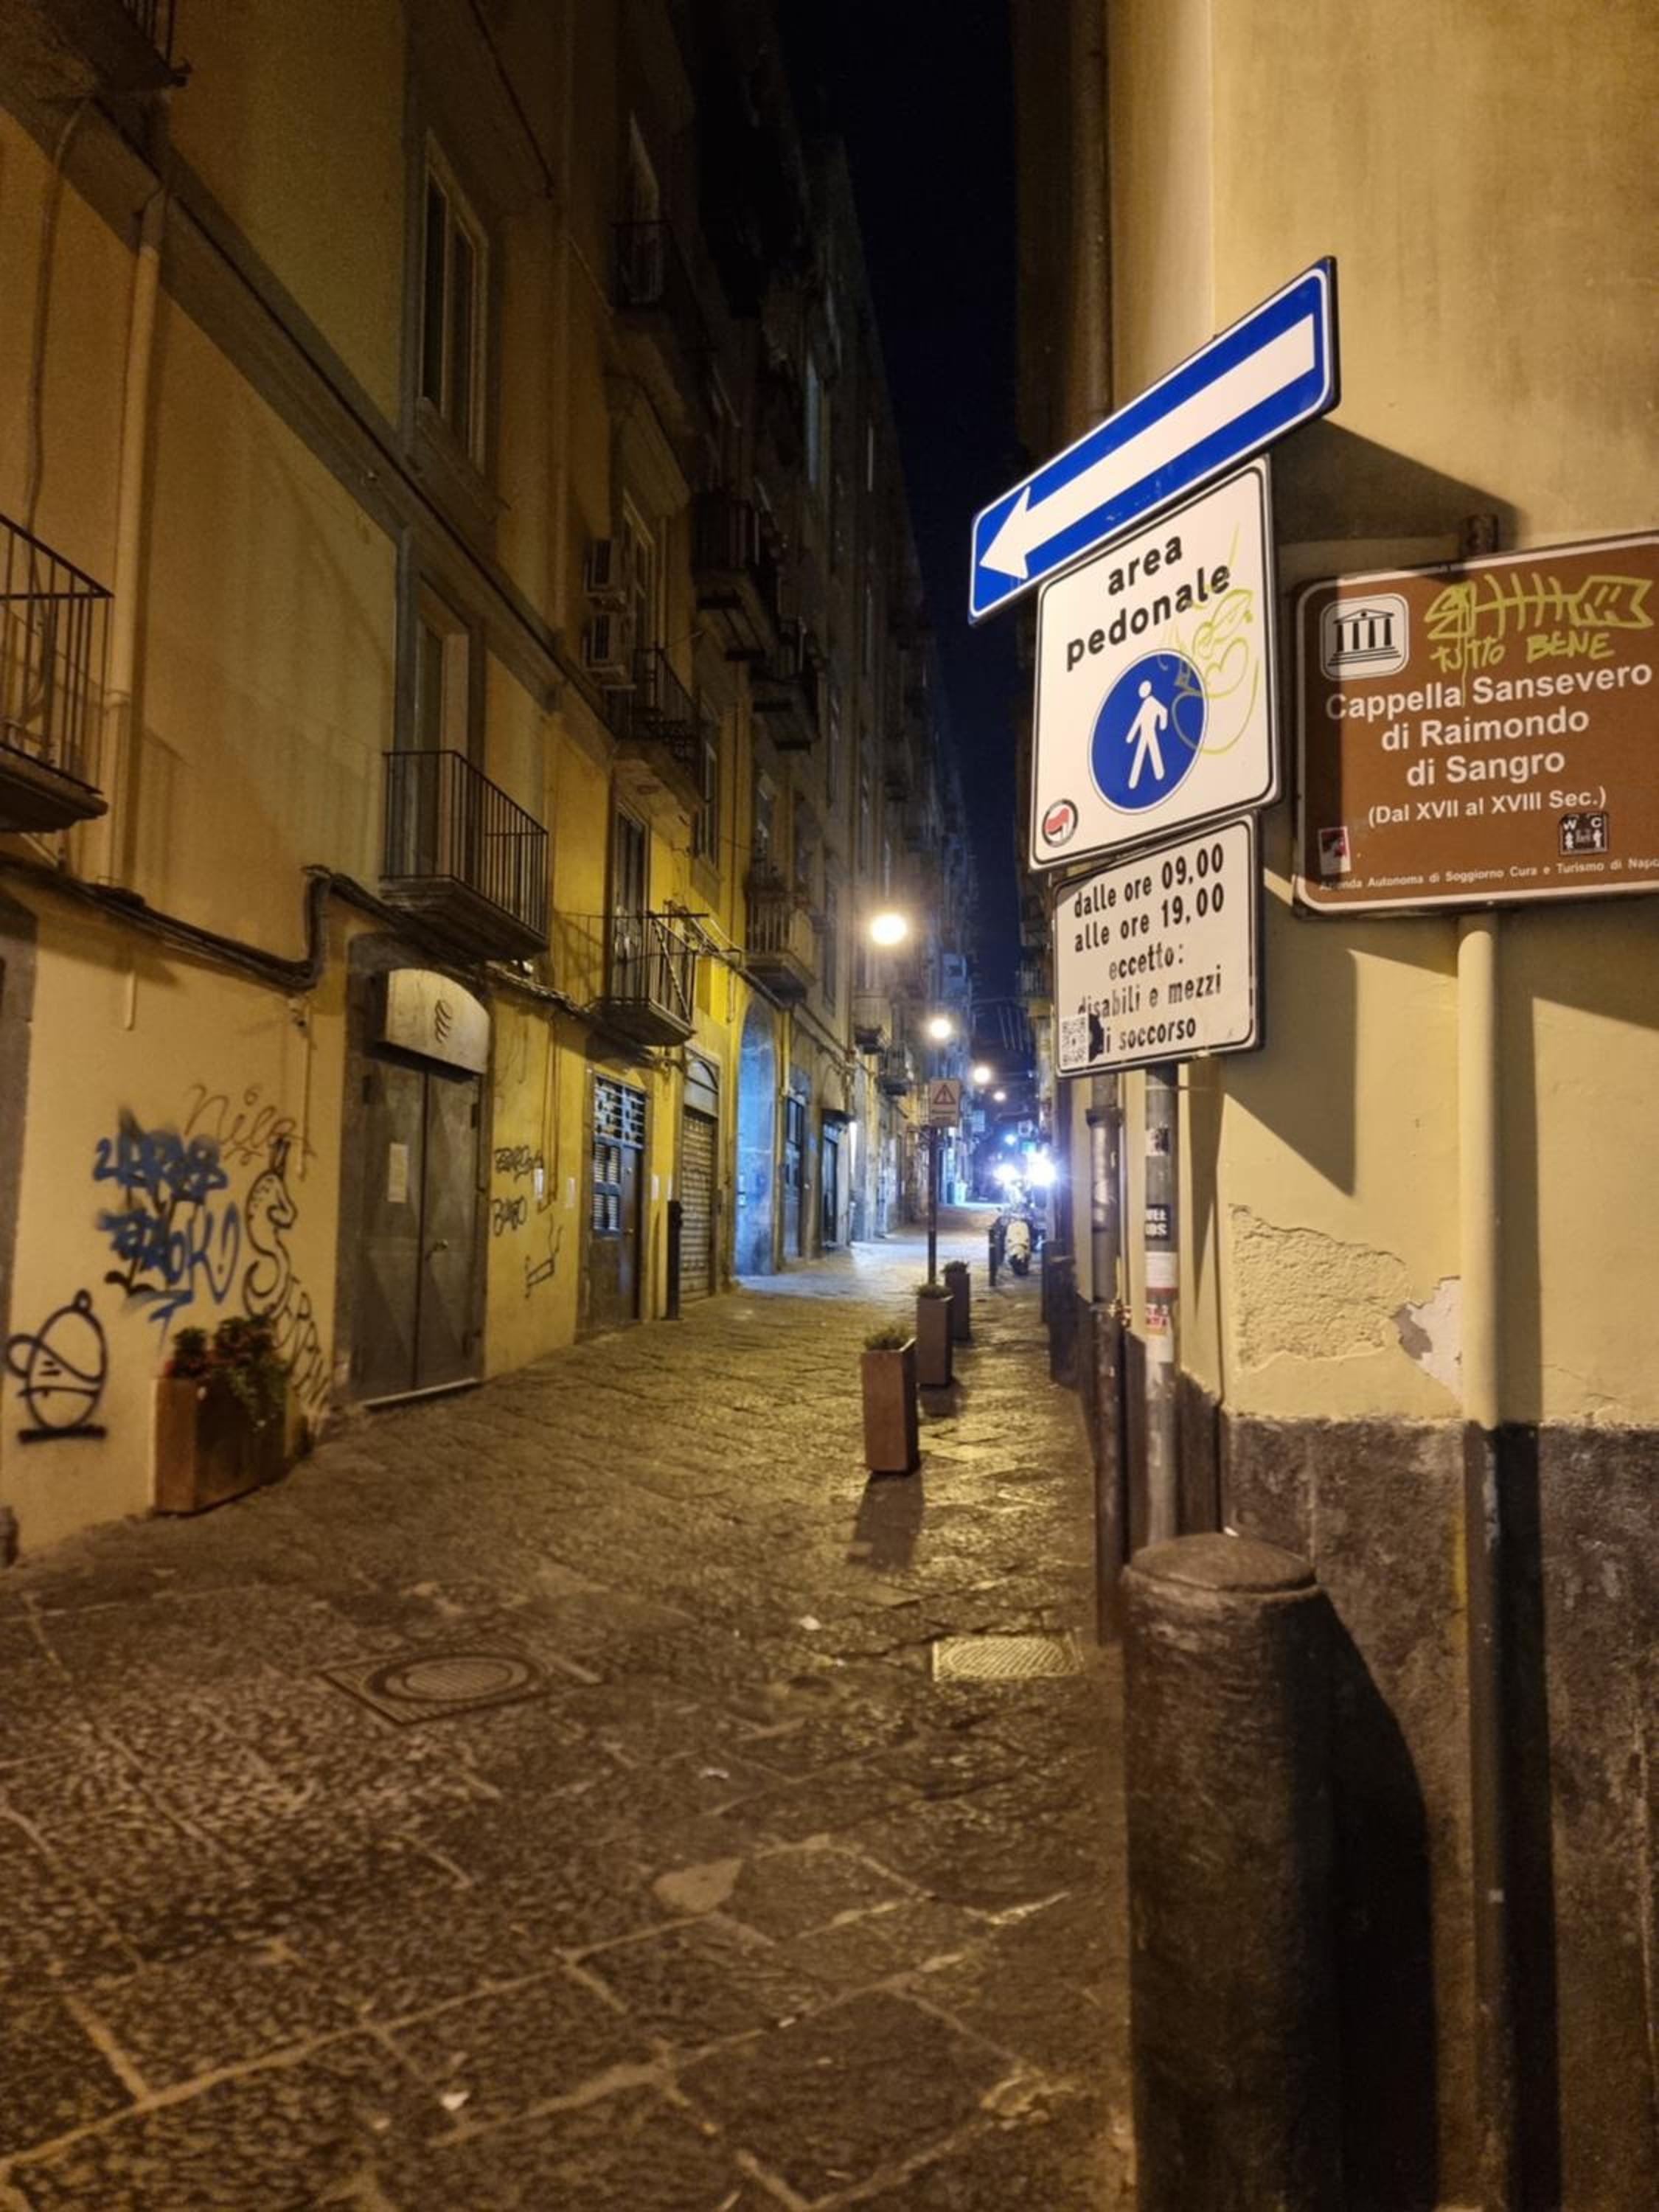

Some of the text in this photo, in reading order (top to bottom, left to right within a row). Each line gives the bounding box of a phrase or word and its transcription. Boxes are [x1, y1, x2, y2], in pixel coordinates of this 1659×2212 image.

[1107, 535, 1183, 596] area
[1066, 566, 1230, 672] pedonale
[1327, 664, 1653, 723] Cappella Sansevero
[1382, 706, 1590, 751] di Raimondo
[1407, 751, 1565, 787] di Sangro
[1368, 786, 1607, 828] (Dal XVII al XVIII Sec.)
[1368, 875, 1424, 888] Autonoma
[1429, 873, 1440, 883] di
[1445, 868, 1504, 884] Soggiorno
[1510, 866, 1537, 877] Cura
[1543, 866, 1551, 875] e
[1556, 861, 1604, 874] Turismo
[1610, 859, 1621, 870] di
[1074, 886, 1117, 919] dalle
[1124, 876, 1152, 902] ore
[1074, 921, 1110, 953] alle
[1120, 914, 1150, 939] ore
[1149, 987, 1158, 1007] e
[1168, 964, 1221, 1005] mezzi
[1119, 1018, 1197, 1051] soccorso
